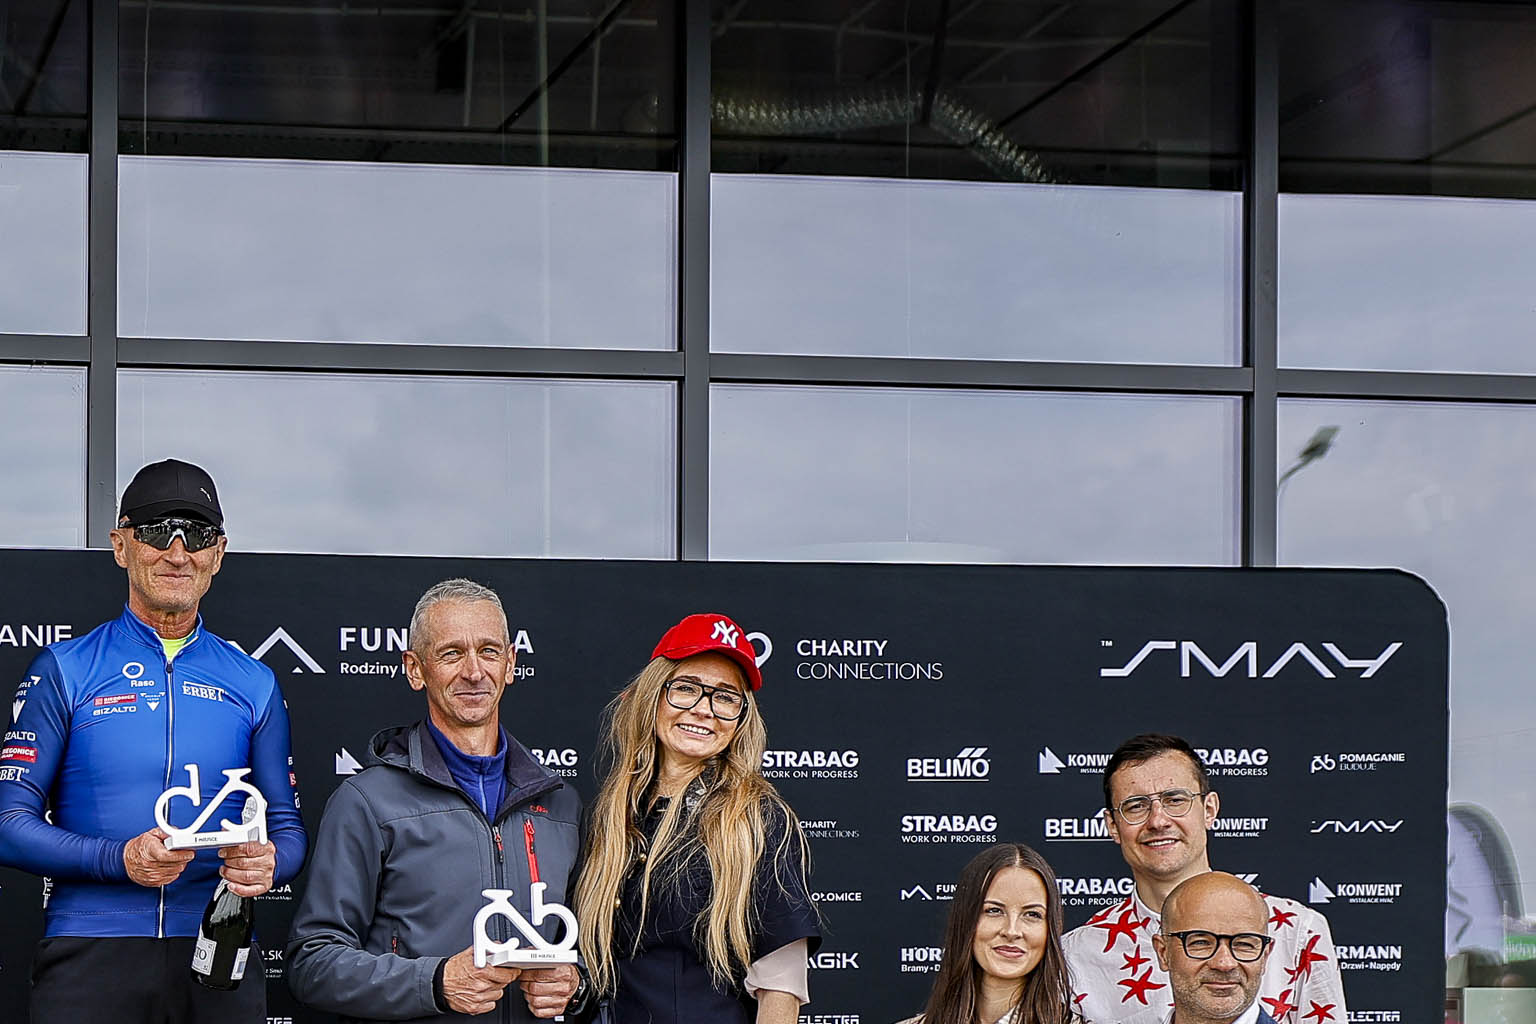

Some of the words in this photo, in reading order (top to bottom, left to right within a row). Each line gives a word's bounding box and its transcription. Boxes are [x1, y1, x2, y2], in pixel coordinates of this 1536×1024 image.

[796, 639, 888, 657] CHARITY
[340, 661, 398, 677] Rodziny
[796, 662, 944, 680] CONNECTIONS
[130, 679, 155, 688] Raso
[763, 750, 859, 769] STRABAG
[1068, 754, 1113, 768] KONW
[1339, 753, 1405, 763] POMAGANIE
[907, 757, 990, 778] BELIMO
[1218, 767, 1269, 777] PROGRESS
[763, 770, 789, 780] WORK
[793, 770, 809, 780] ON
[812, 770, 859, 780] PROGRESS
[799, 819, 837, 829] CHARITY
[901, 814, 998, 833] STRABAG
[1045, 818, 1108, 837] BELIM
[901, 834, 930, 843] WORK
[931, 834, 948, 843] ON
[950, 834, 997, 843] PROGRESS
[1056, 878, 1135, 896] TRABAG
[1337, 884, 1403, 898] KONWENT
[1336, 945, 1402, 960] RMANN
[901, 964, 929, 974] Bramy
